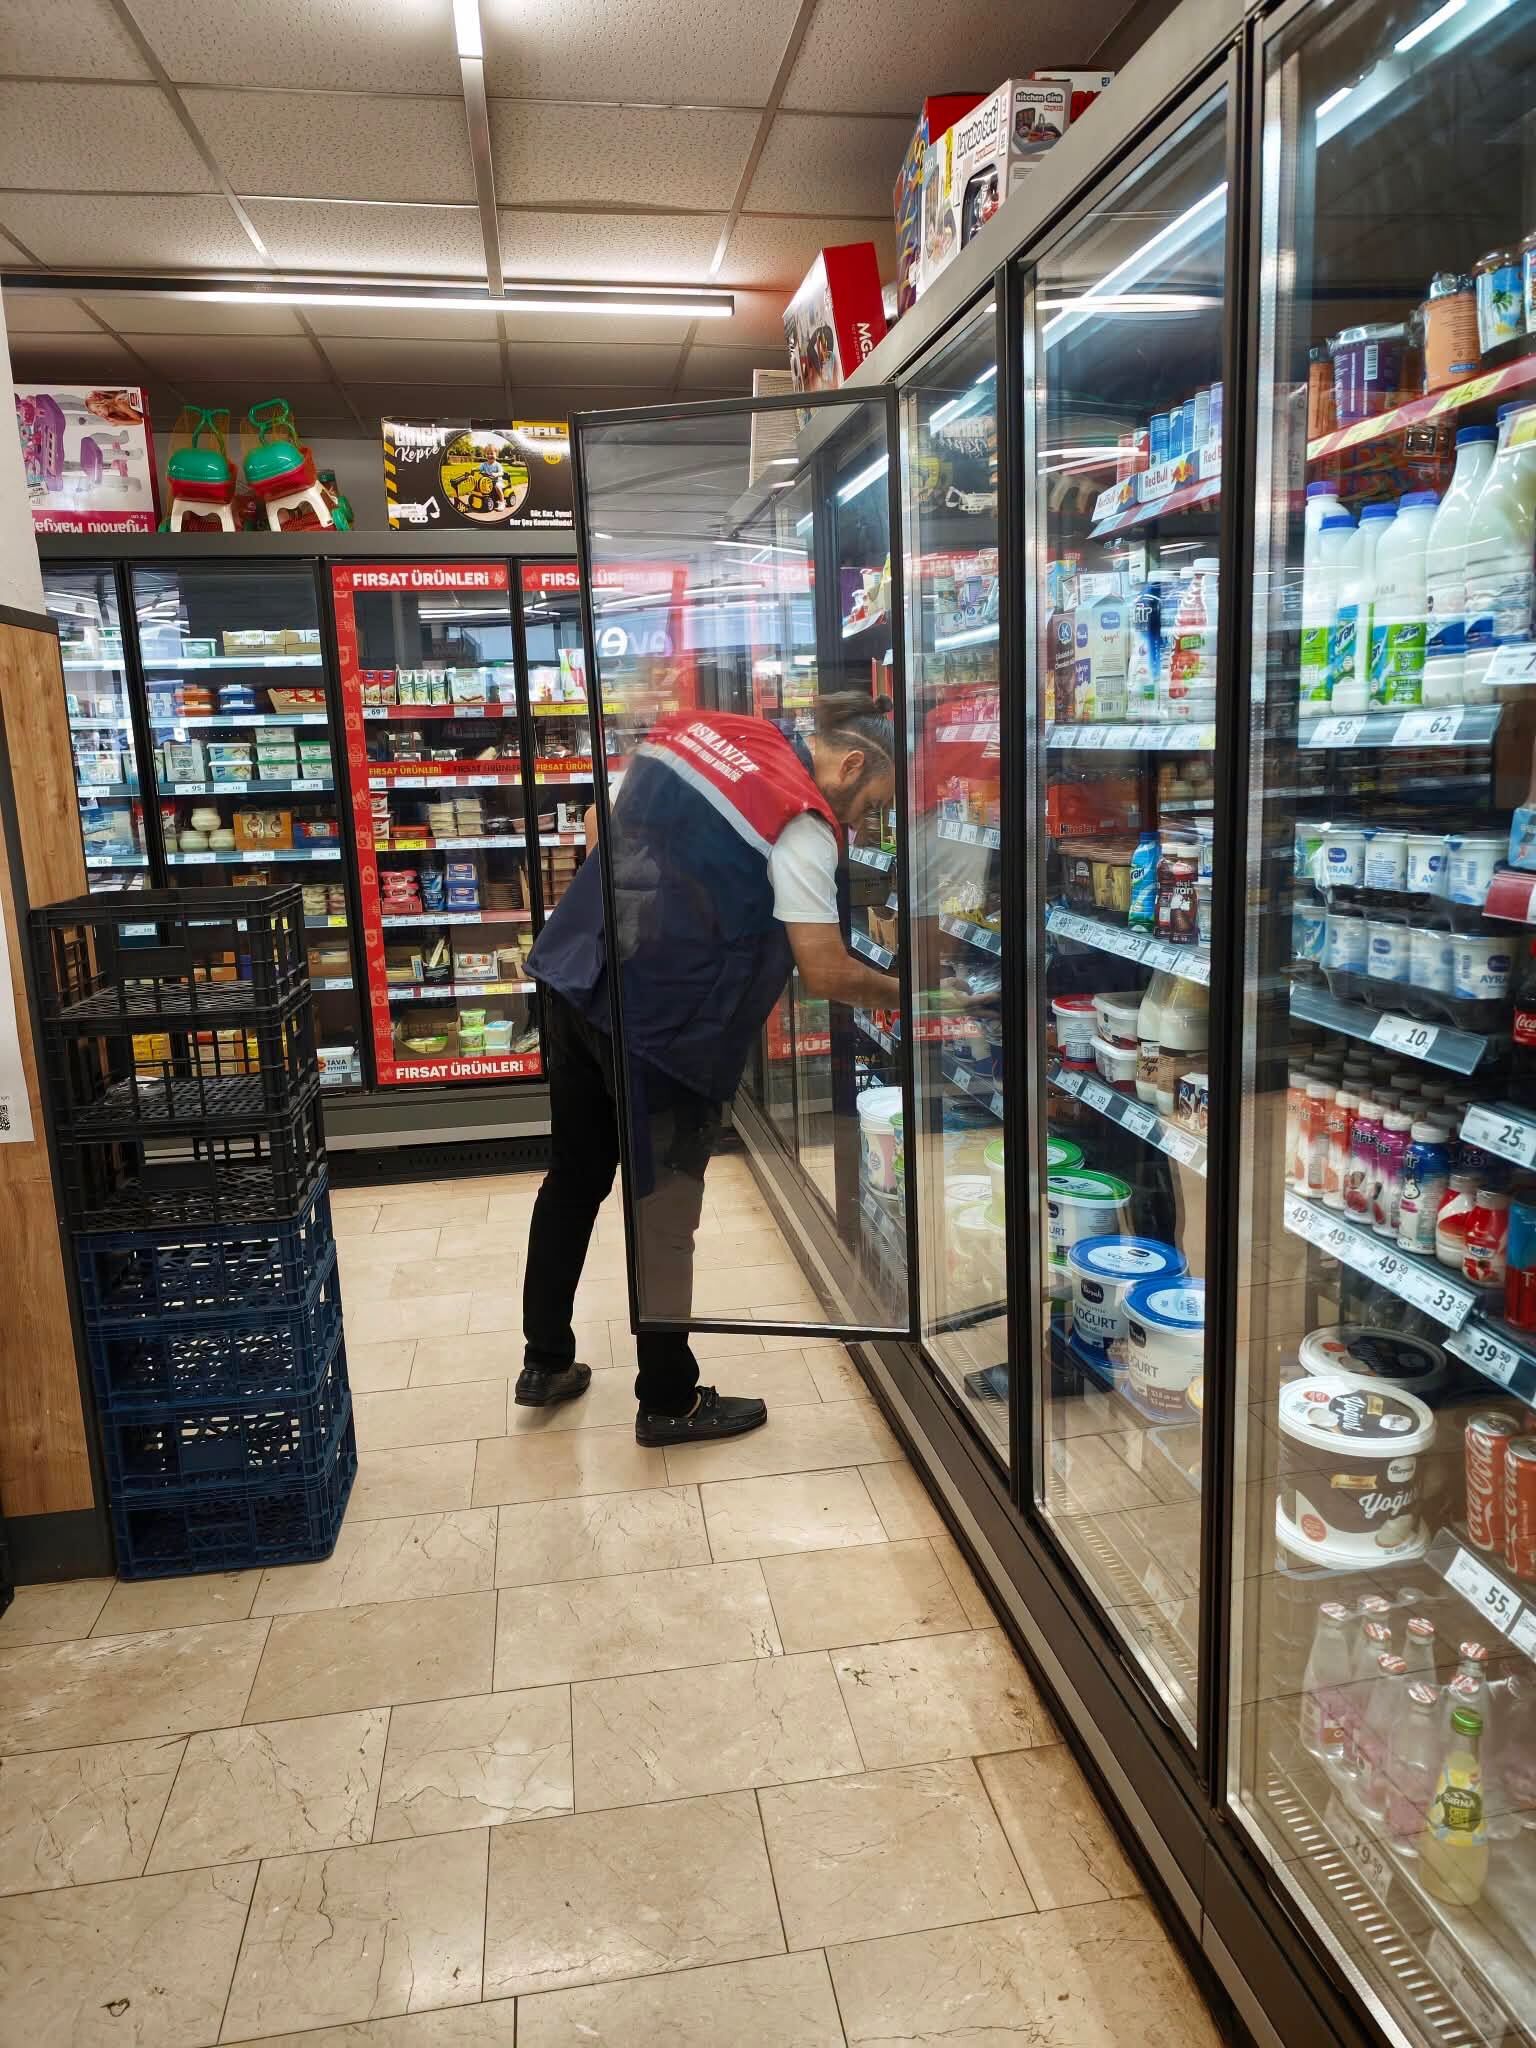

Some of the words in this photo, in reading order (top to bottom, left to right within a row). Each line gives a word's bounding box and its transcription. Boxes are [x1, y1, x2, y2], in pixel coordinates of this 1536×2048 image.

[353, 572, 409, 586] FIRSAT
[541, 572, 580, 586] FIRSA
[1405, 1027, 1428, 1046] 10
[396, 1066, 449, 1080] FIRSAT
[1500, 1124, 1525, 1147] 25
[1291, 1207, 1308, 1222] 49
[1328, 1228, 1346, 1245] 49
[1378, 1255, 1397, 1274] 49
[1433, 1289, 1456, 1312] 33
[1474, 1338, 1498, 1362] 39
[1485, 1585, 1510, 1613] 55
